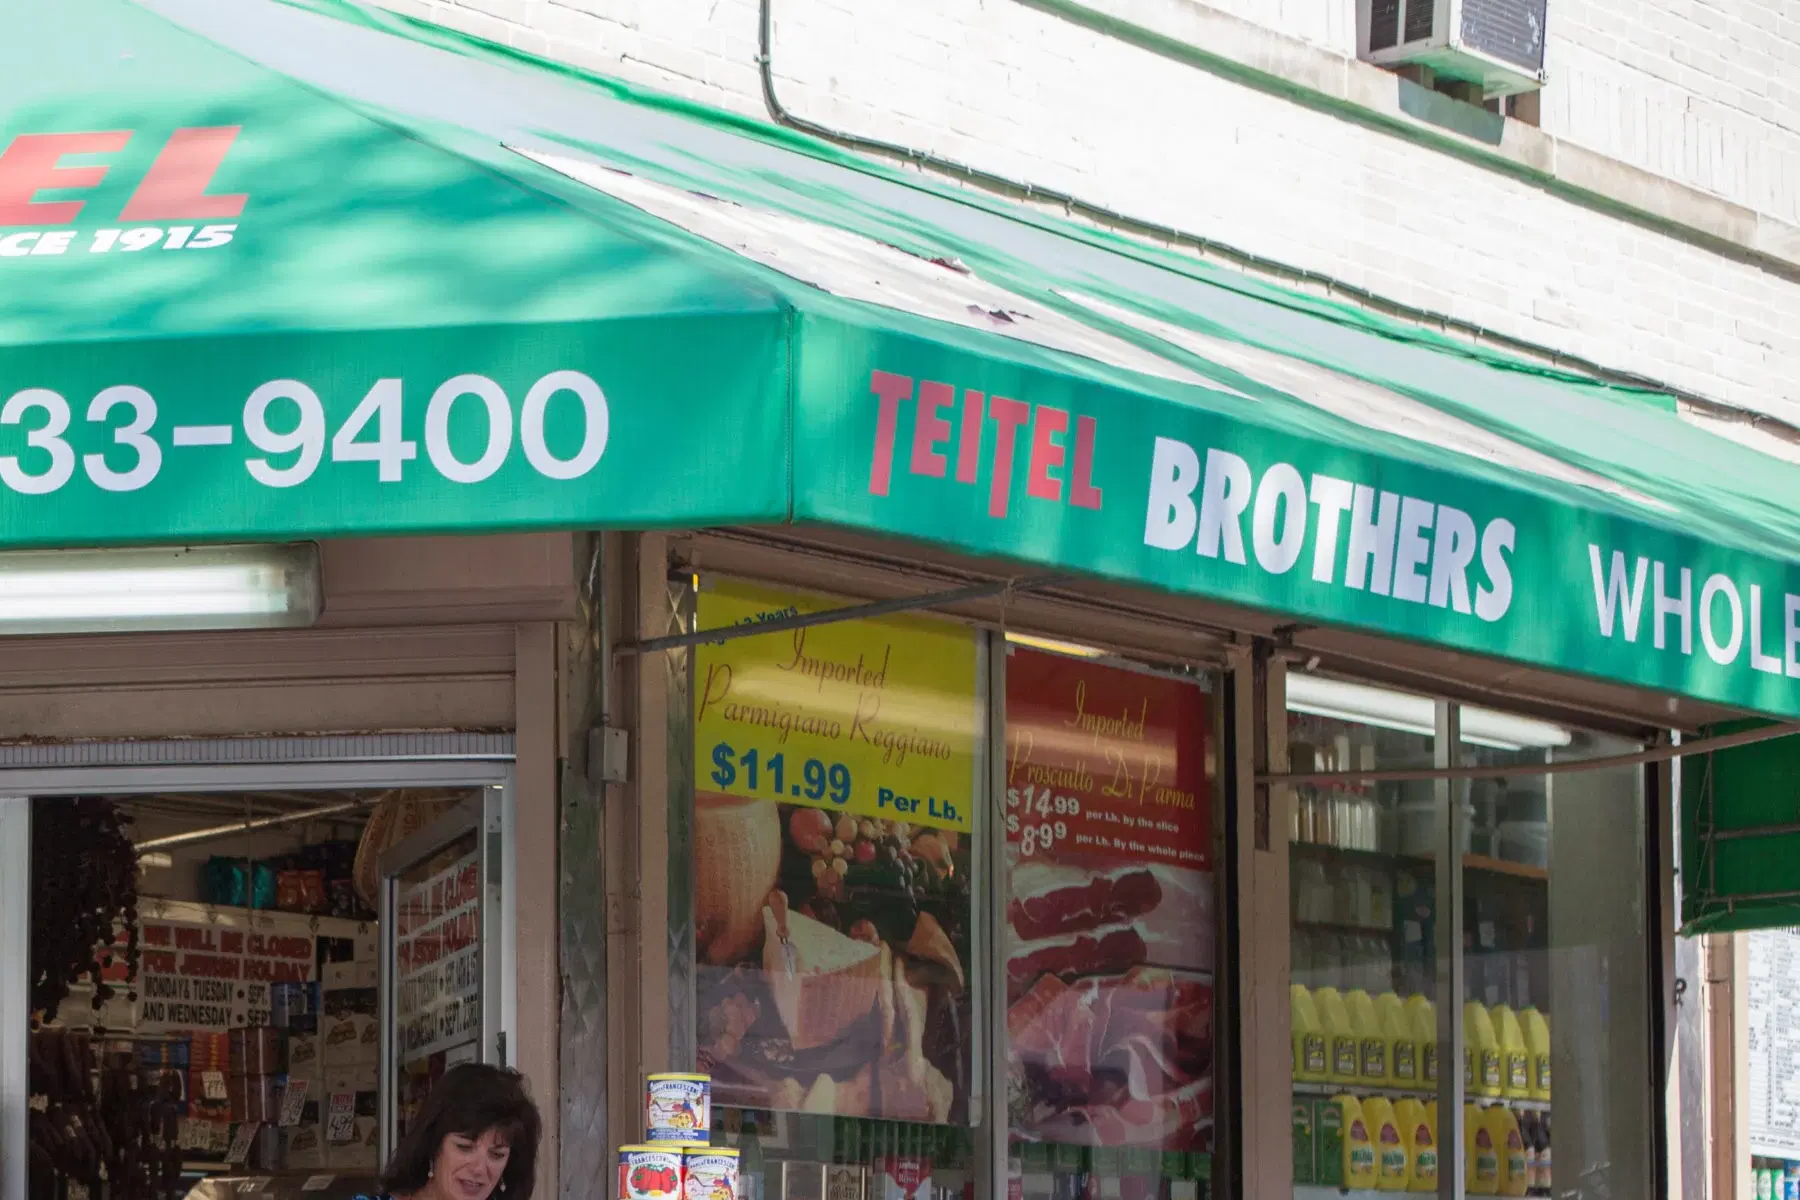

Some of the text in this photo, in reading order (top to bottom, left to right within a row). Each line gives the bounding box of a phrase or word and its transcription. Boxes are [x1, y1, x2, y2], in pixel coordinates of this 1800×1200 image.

[87, 223, 238, 253] 1915
[869, 370, 1103, 519] TEITEL
[1144, 436, 1516, 622] BROTHERS
[776, 626, 892, 693] Imported
[697, 663, 952, 767] Parmigiano Reggiano
[1064, 680, 1148, 748] Imported
[710, 740, 964, 823] $11.99 Per Lb.
[1010, 728, 1196, 811] Prosciutto Di Parma
[1007, 784, 1080, 818] $14.99
[1086, 810, 1102, 821] per
[1123, 816, 1135, 827] by
[1137, 817, 1154, 829] the
[1155, 820, 1179, 834] slice
[1076, 834, 1093, 844] per
[1114, 840, 1127, 851] By
[1130, 841, 1146, 853] the
[1148, 844, 1177, 858] whole
[1180, 850, 1205, 862] piece
[248, 934, 312, 960] CLOSED
[144, 1001, 233, 1027] AND WEDNESDAY
[193, 980, 234, 1005] TUESDAY
